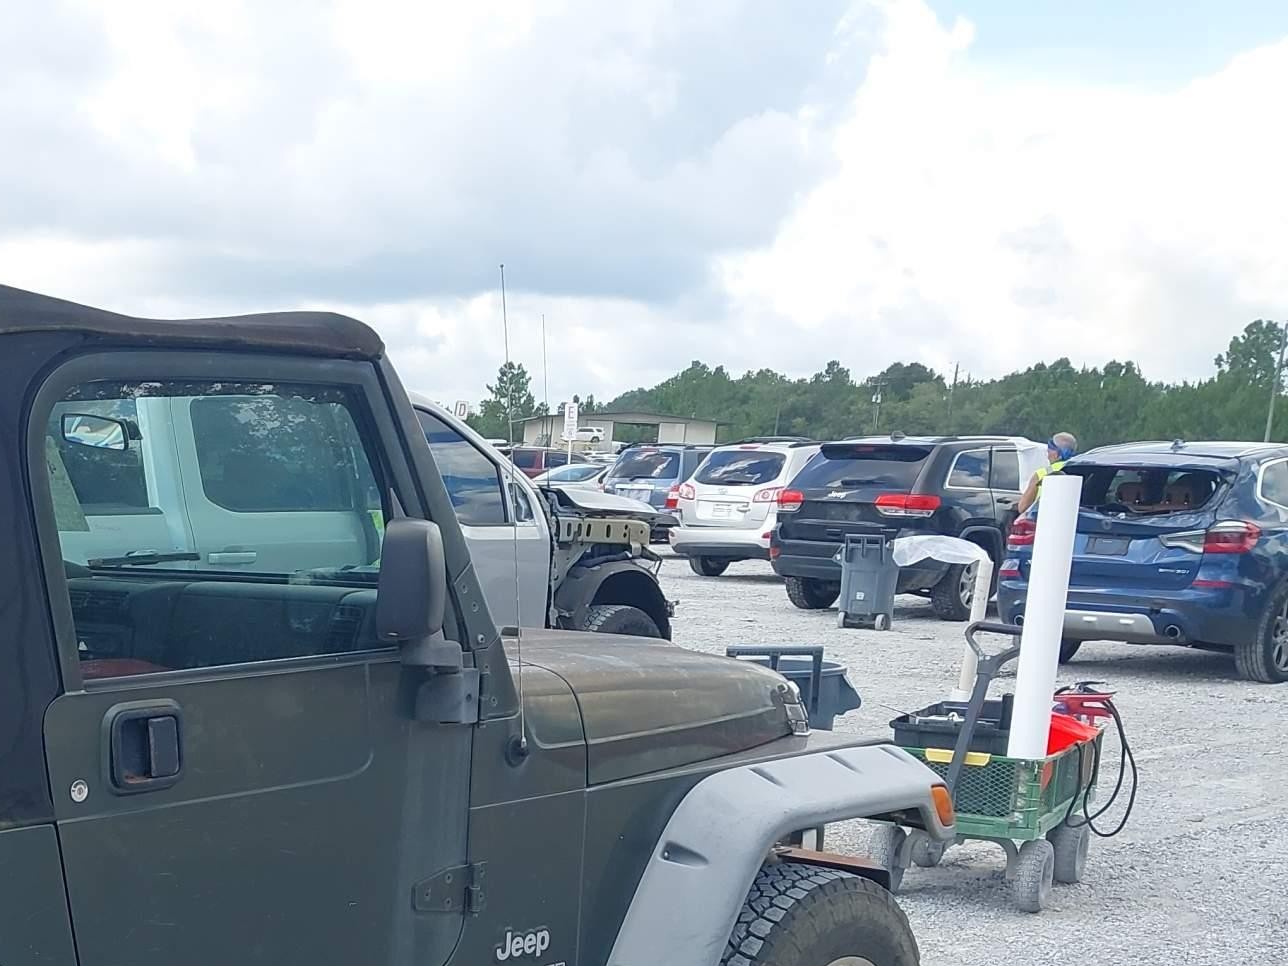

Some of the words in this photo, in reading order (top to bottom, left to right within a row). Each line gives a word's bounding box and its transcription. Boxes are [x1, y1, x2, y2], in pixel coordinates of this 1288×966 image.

[458, 402, 467, 417] D
[565, 406, 575, 419] E
[496, 929, 550, 961] Jeep
